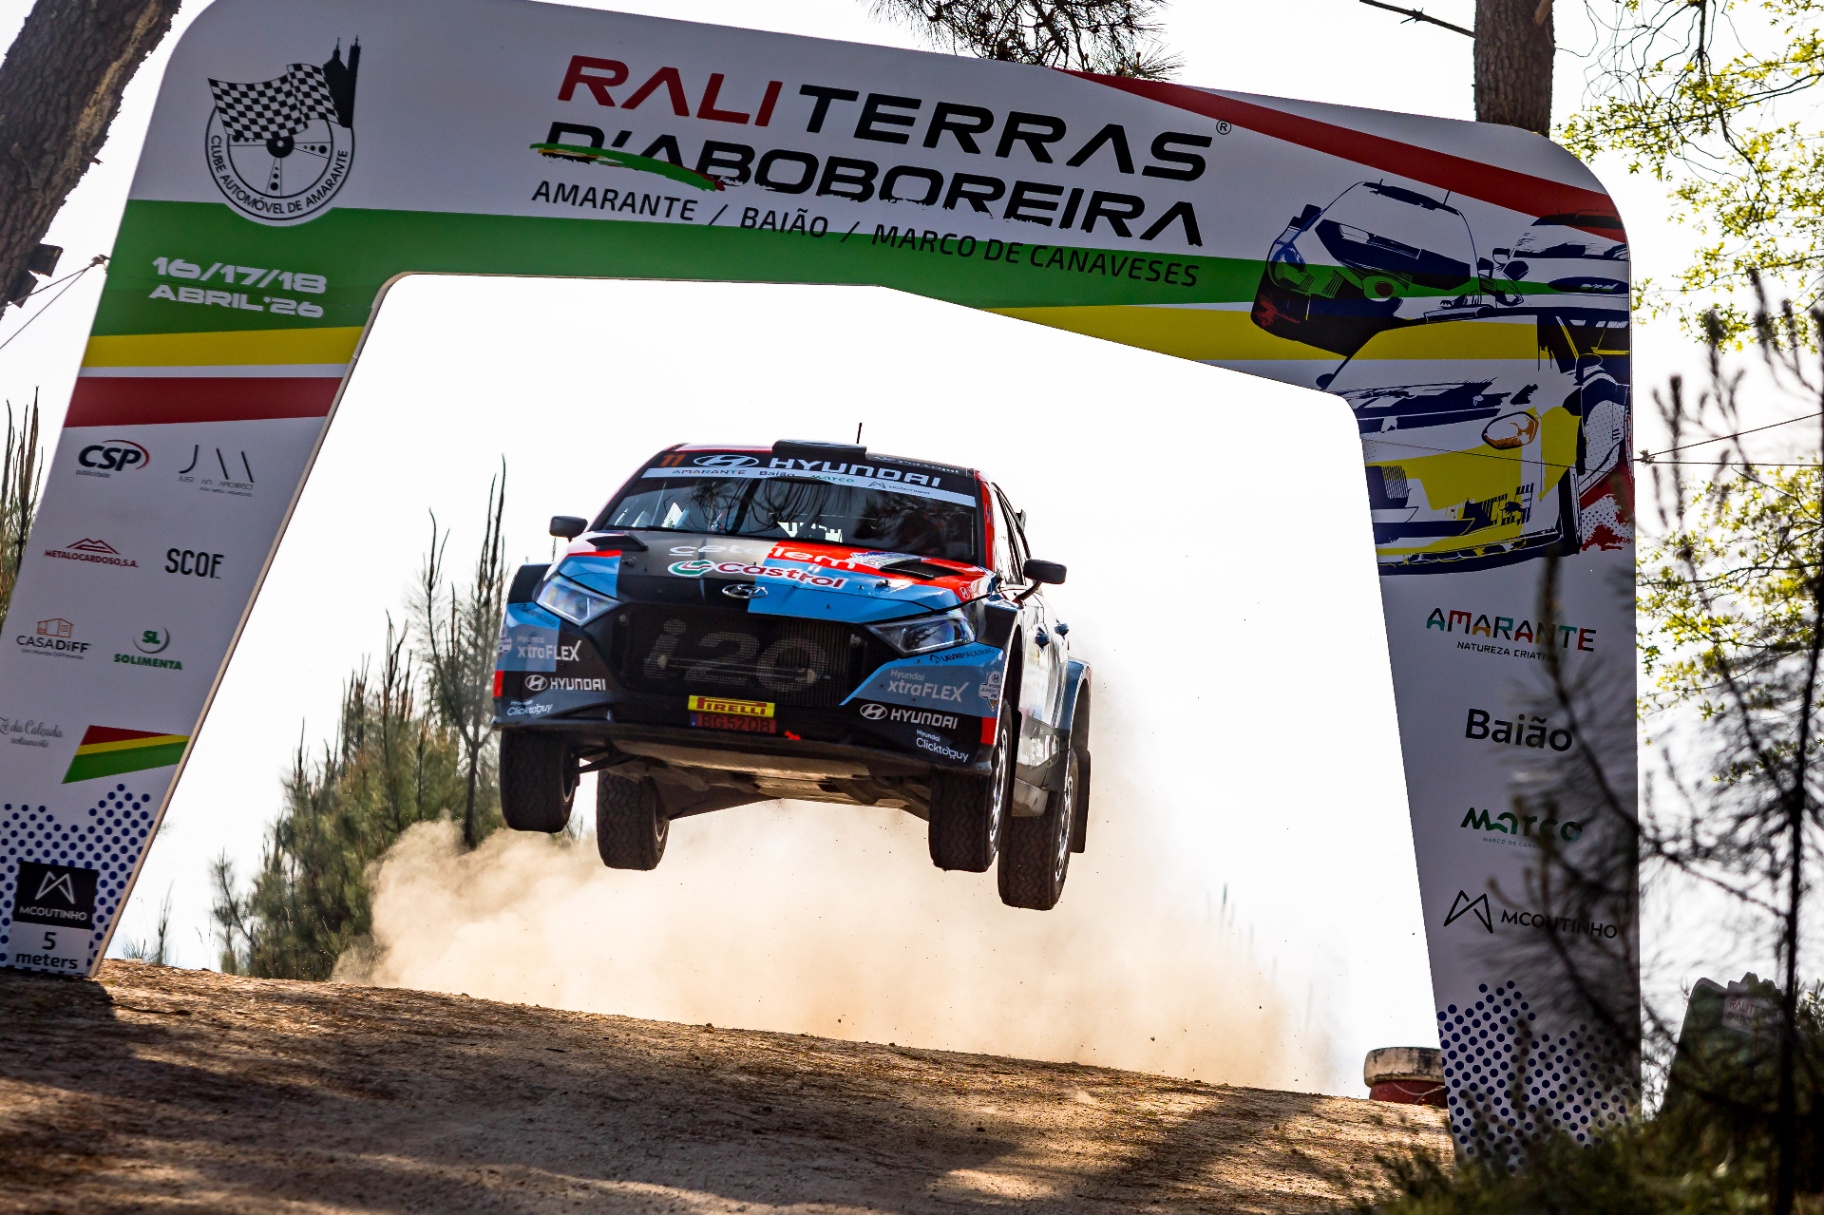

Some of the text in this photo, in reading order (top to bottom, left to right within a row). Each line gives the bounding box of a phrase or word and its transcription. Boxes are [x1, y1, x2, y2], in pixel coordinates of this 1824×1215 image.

[557, 54, 1213, 182] RALI TERRAS
[211, 135, 349, 215] CLUBE AUTOMÓVEL DE AMARANTE
[532, 180, 699, 222] AMARANTE
[740, 206, 829, 239] BAIÃO
[872, 224, 978, 259] MARCO
[984, 238, 1023, 265] DE
[1029, 244, 1201, 288] CANAVESES
[152, 256, 328, 295] 16/17/18
[78, 445, 142, 472] CSP
[659, 454, 687, 468] 11
[768, 457, 942, 488] HYUNDAI
[165, 548, 225, 579] SCOF
[717, 561, 848, 590] Castrol
[142, 630, 162, 645] SL
[1426, 607, 1598, 653] AMARANTE
[517, 639, 582, 662] xtraFLEX
[643, 618, 827, 693] i20
[1457, 640, 1511, 657] NATUREZA
[113, 653, 184, 671] SOLIMENTA
[549, 677, 607, 691] HYUNDAI
[890, 669, 926, 681] Hyundai
[886, 680, 970, 703] xtraFLEX
[696, 696, 768, 716] PIRELLI
[890, 708, 958, 730] HYUNDAI
[1465, 708, 1573, 752] Baião
[916, 729, 942, 743] Hyundai
[19, 904, 88, 922] MCOUTINHO
[42, 930, 57, 951] 5
[16, 951, 78, 970] meters
